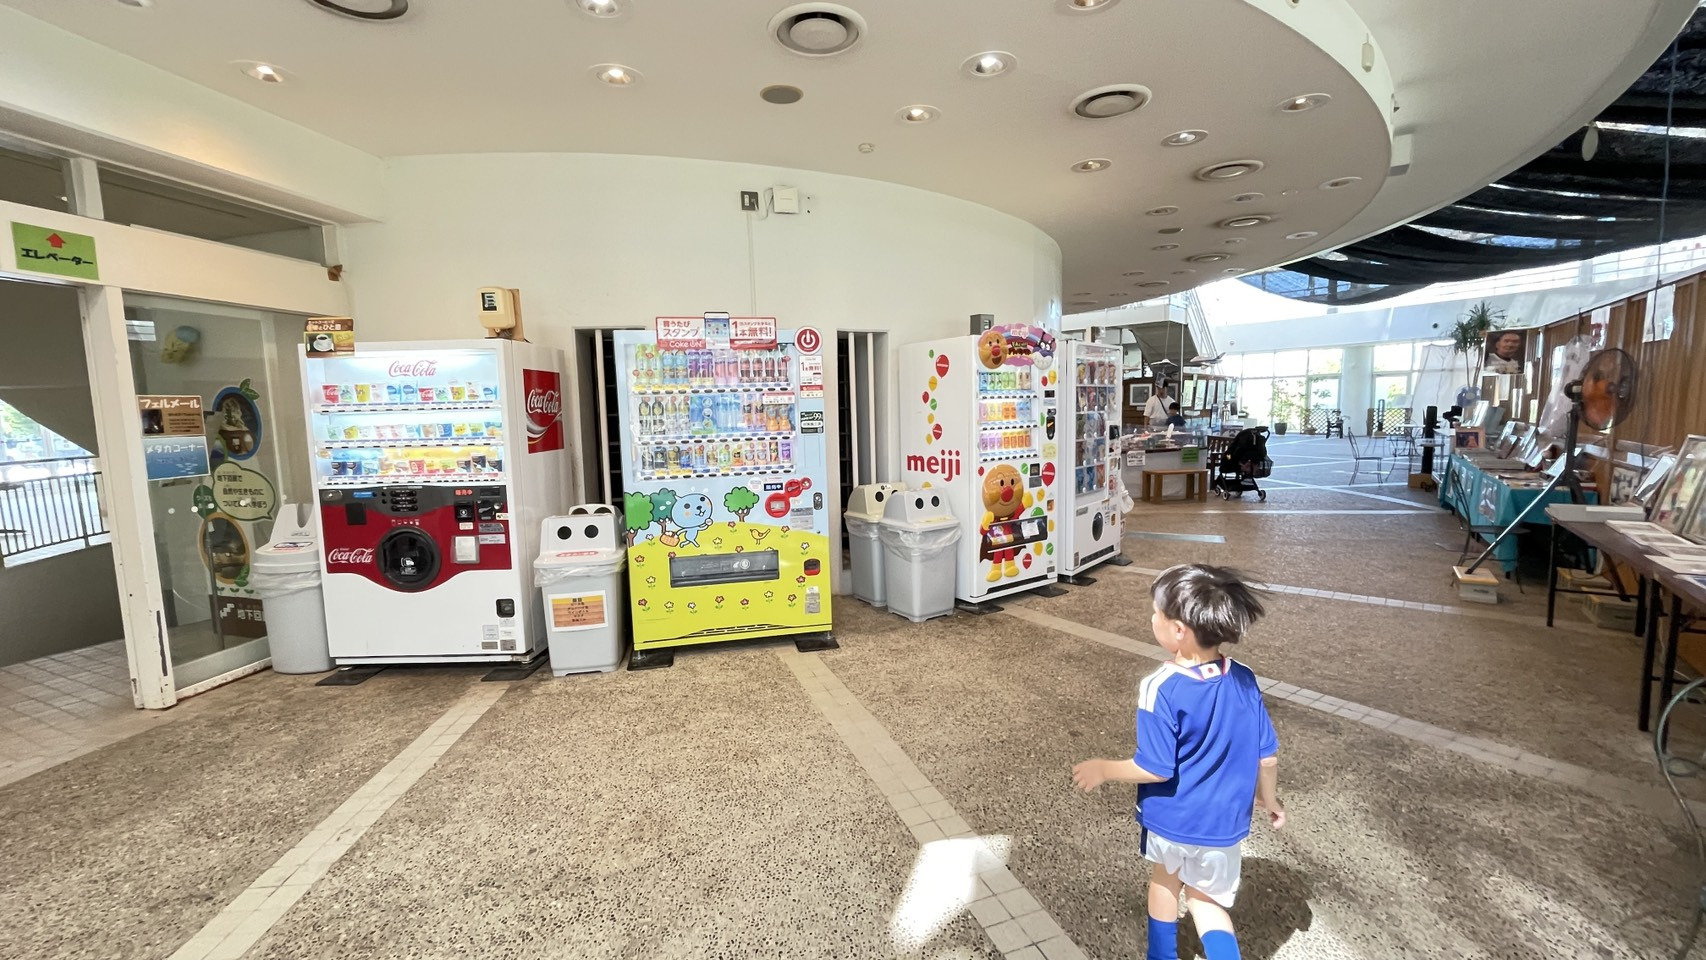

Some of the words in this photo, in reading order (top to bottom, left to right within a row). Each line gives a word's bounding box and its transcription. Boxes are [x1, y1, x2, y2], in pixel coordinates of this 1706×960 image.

[20, 247, 94, 266] エレベーター
[663, 328, 700, 337] スタンプ
[388, 359, 438, 378] Coca-Cola
[139, 398, 201, 409] フェルメール
[527, 388, 560, 414] Coca-Cola
[906, 449, 960, 482] meiji
[328, 548, 375, 564] Coca-Cola
